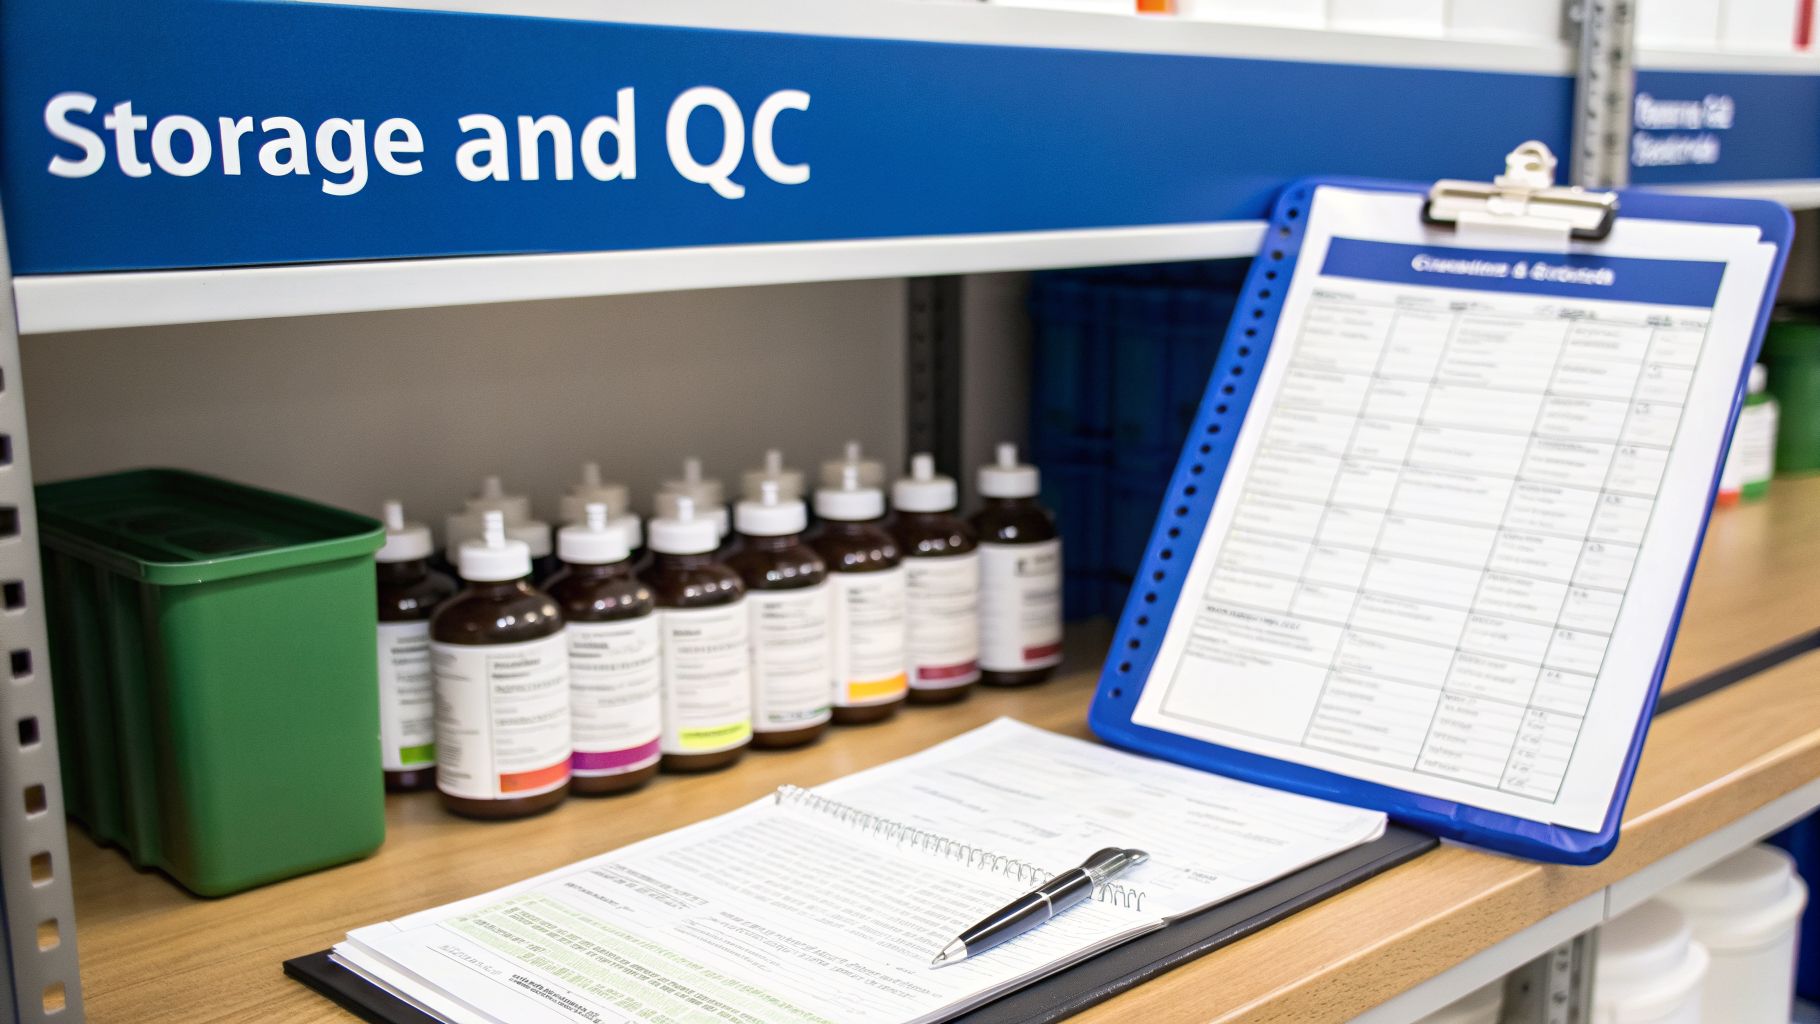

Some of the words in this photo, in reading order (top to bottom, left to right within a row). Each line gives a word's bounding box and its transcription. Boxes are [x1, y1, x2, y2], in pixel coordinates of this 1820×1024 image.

[44, 91, 424, 196] Storage
[455, 87, 637, 182] and
[665, 86, 811, 200] QC
